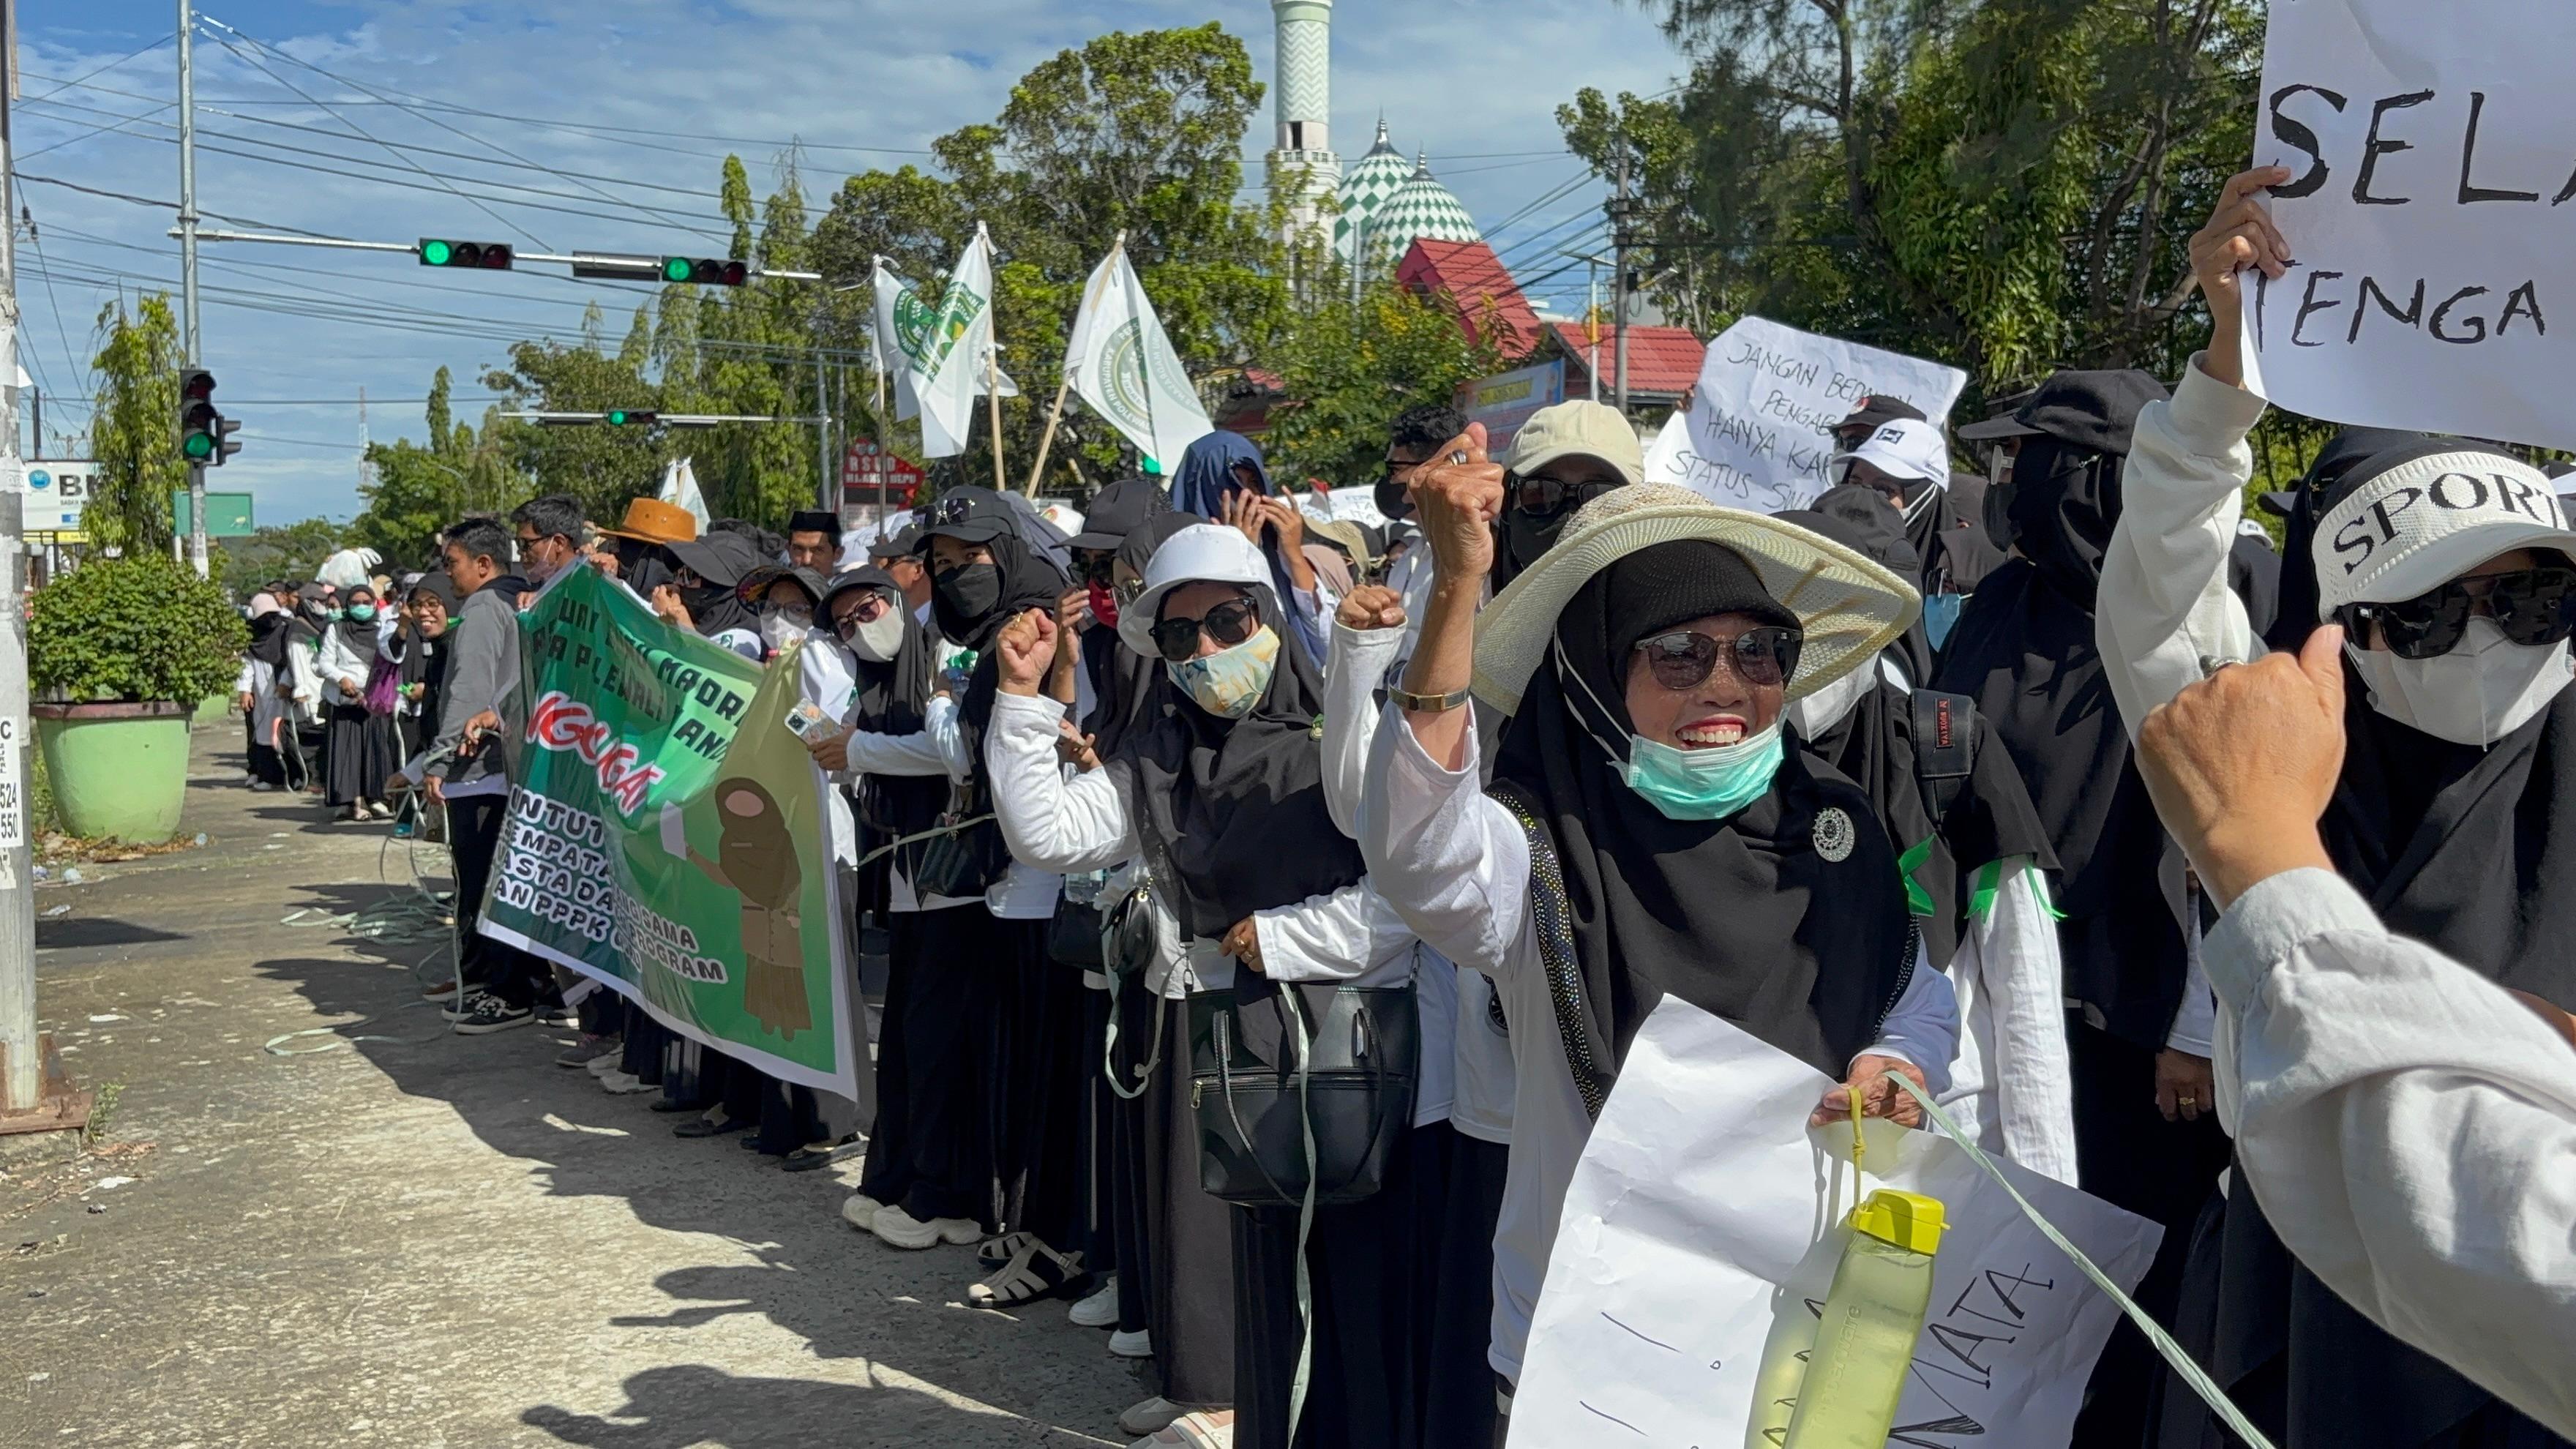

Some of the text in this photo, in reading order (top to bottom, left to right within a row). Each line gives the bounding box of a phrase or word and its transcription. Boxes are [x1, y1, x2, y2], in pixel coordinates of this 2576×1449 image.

[1727, 342, 1819, 389] JANGAN
[1704, 407, 1777, 461] HANYA
[1666, 449, 1752, 499] STATUS
[532, 892, 609, 942] PPPK
[629, 920, 726, 982] PROGRAM
